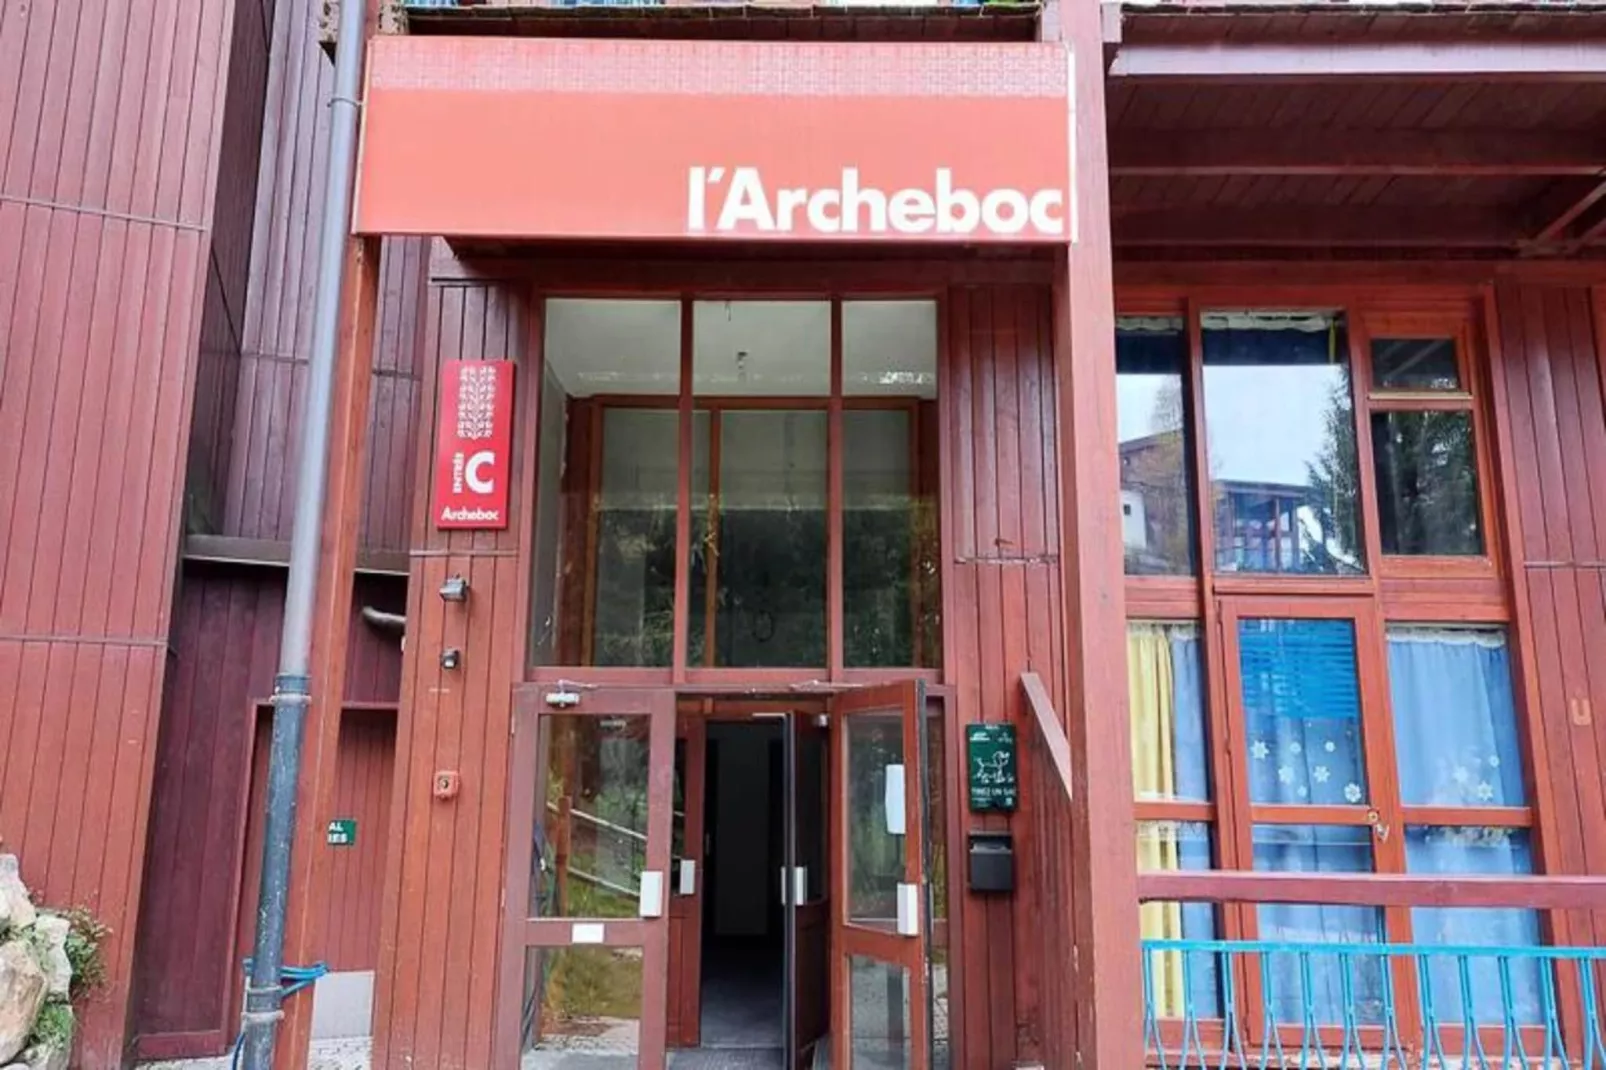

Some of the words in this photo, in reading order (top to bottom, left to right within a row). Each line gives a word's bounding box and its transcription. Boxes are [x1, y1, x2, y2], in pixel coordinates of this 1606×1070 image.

[687, 165, 1064, 235] l'Archeboc
[465, 449, 495, 494] C
[440, 506, 499, 521] Archeboc
